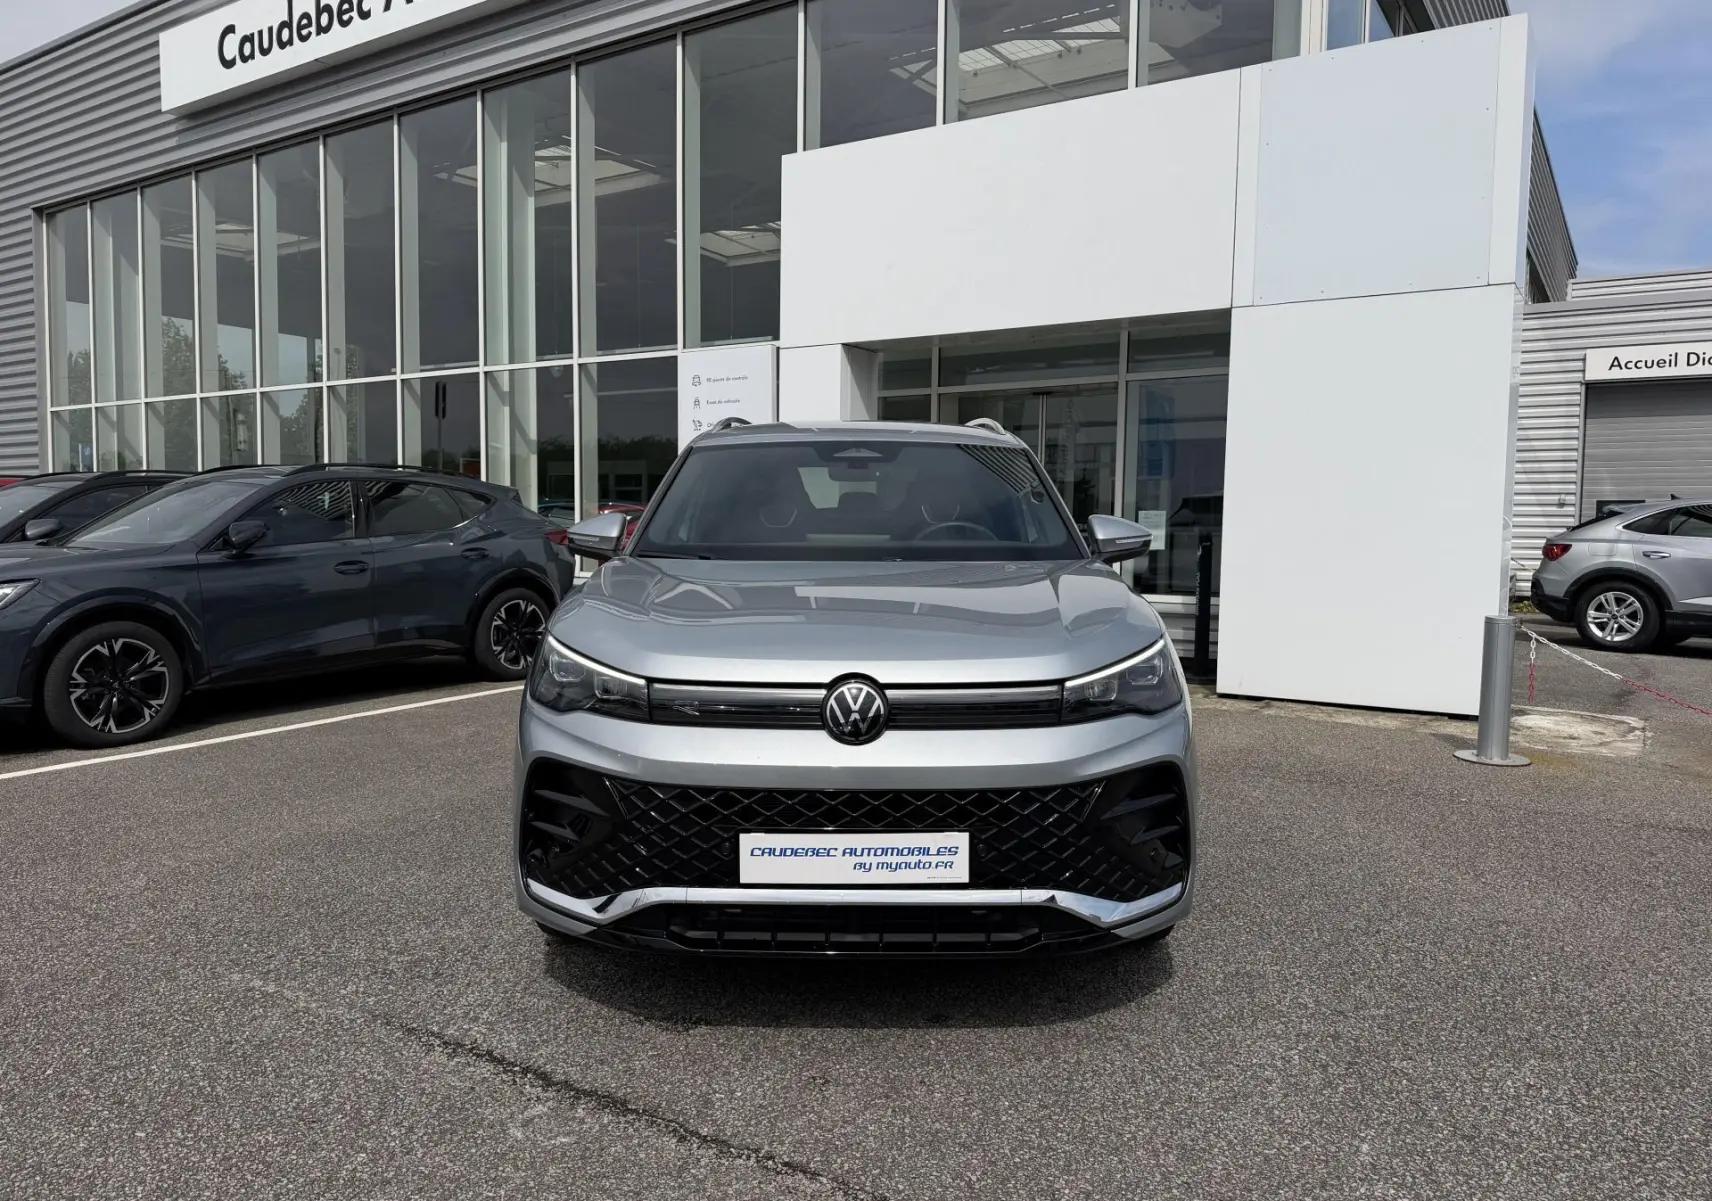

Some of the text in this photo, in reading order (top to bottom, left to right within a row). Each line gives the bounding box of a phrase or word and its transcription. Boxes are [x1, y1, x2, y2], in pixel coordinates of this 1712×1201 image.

[217, 0, 372, 69] Caudebec
[1608, 352, 1678, 371] Accueil
[827, 683, 884, 740] VW
[750, 846, 959, 857] CAUDEBEC AUTOMOBILES
